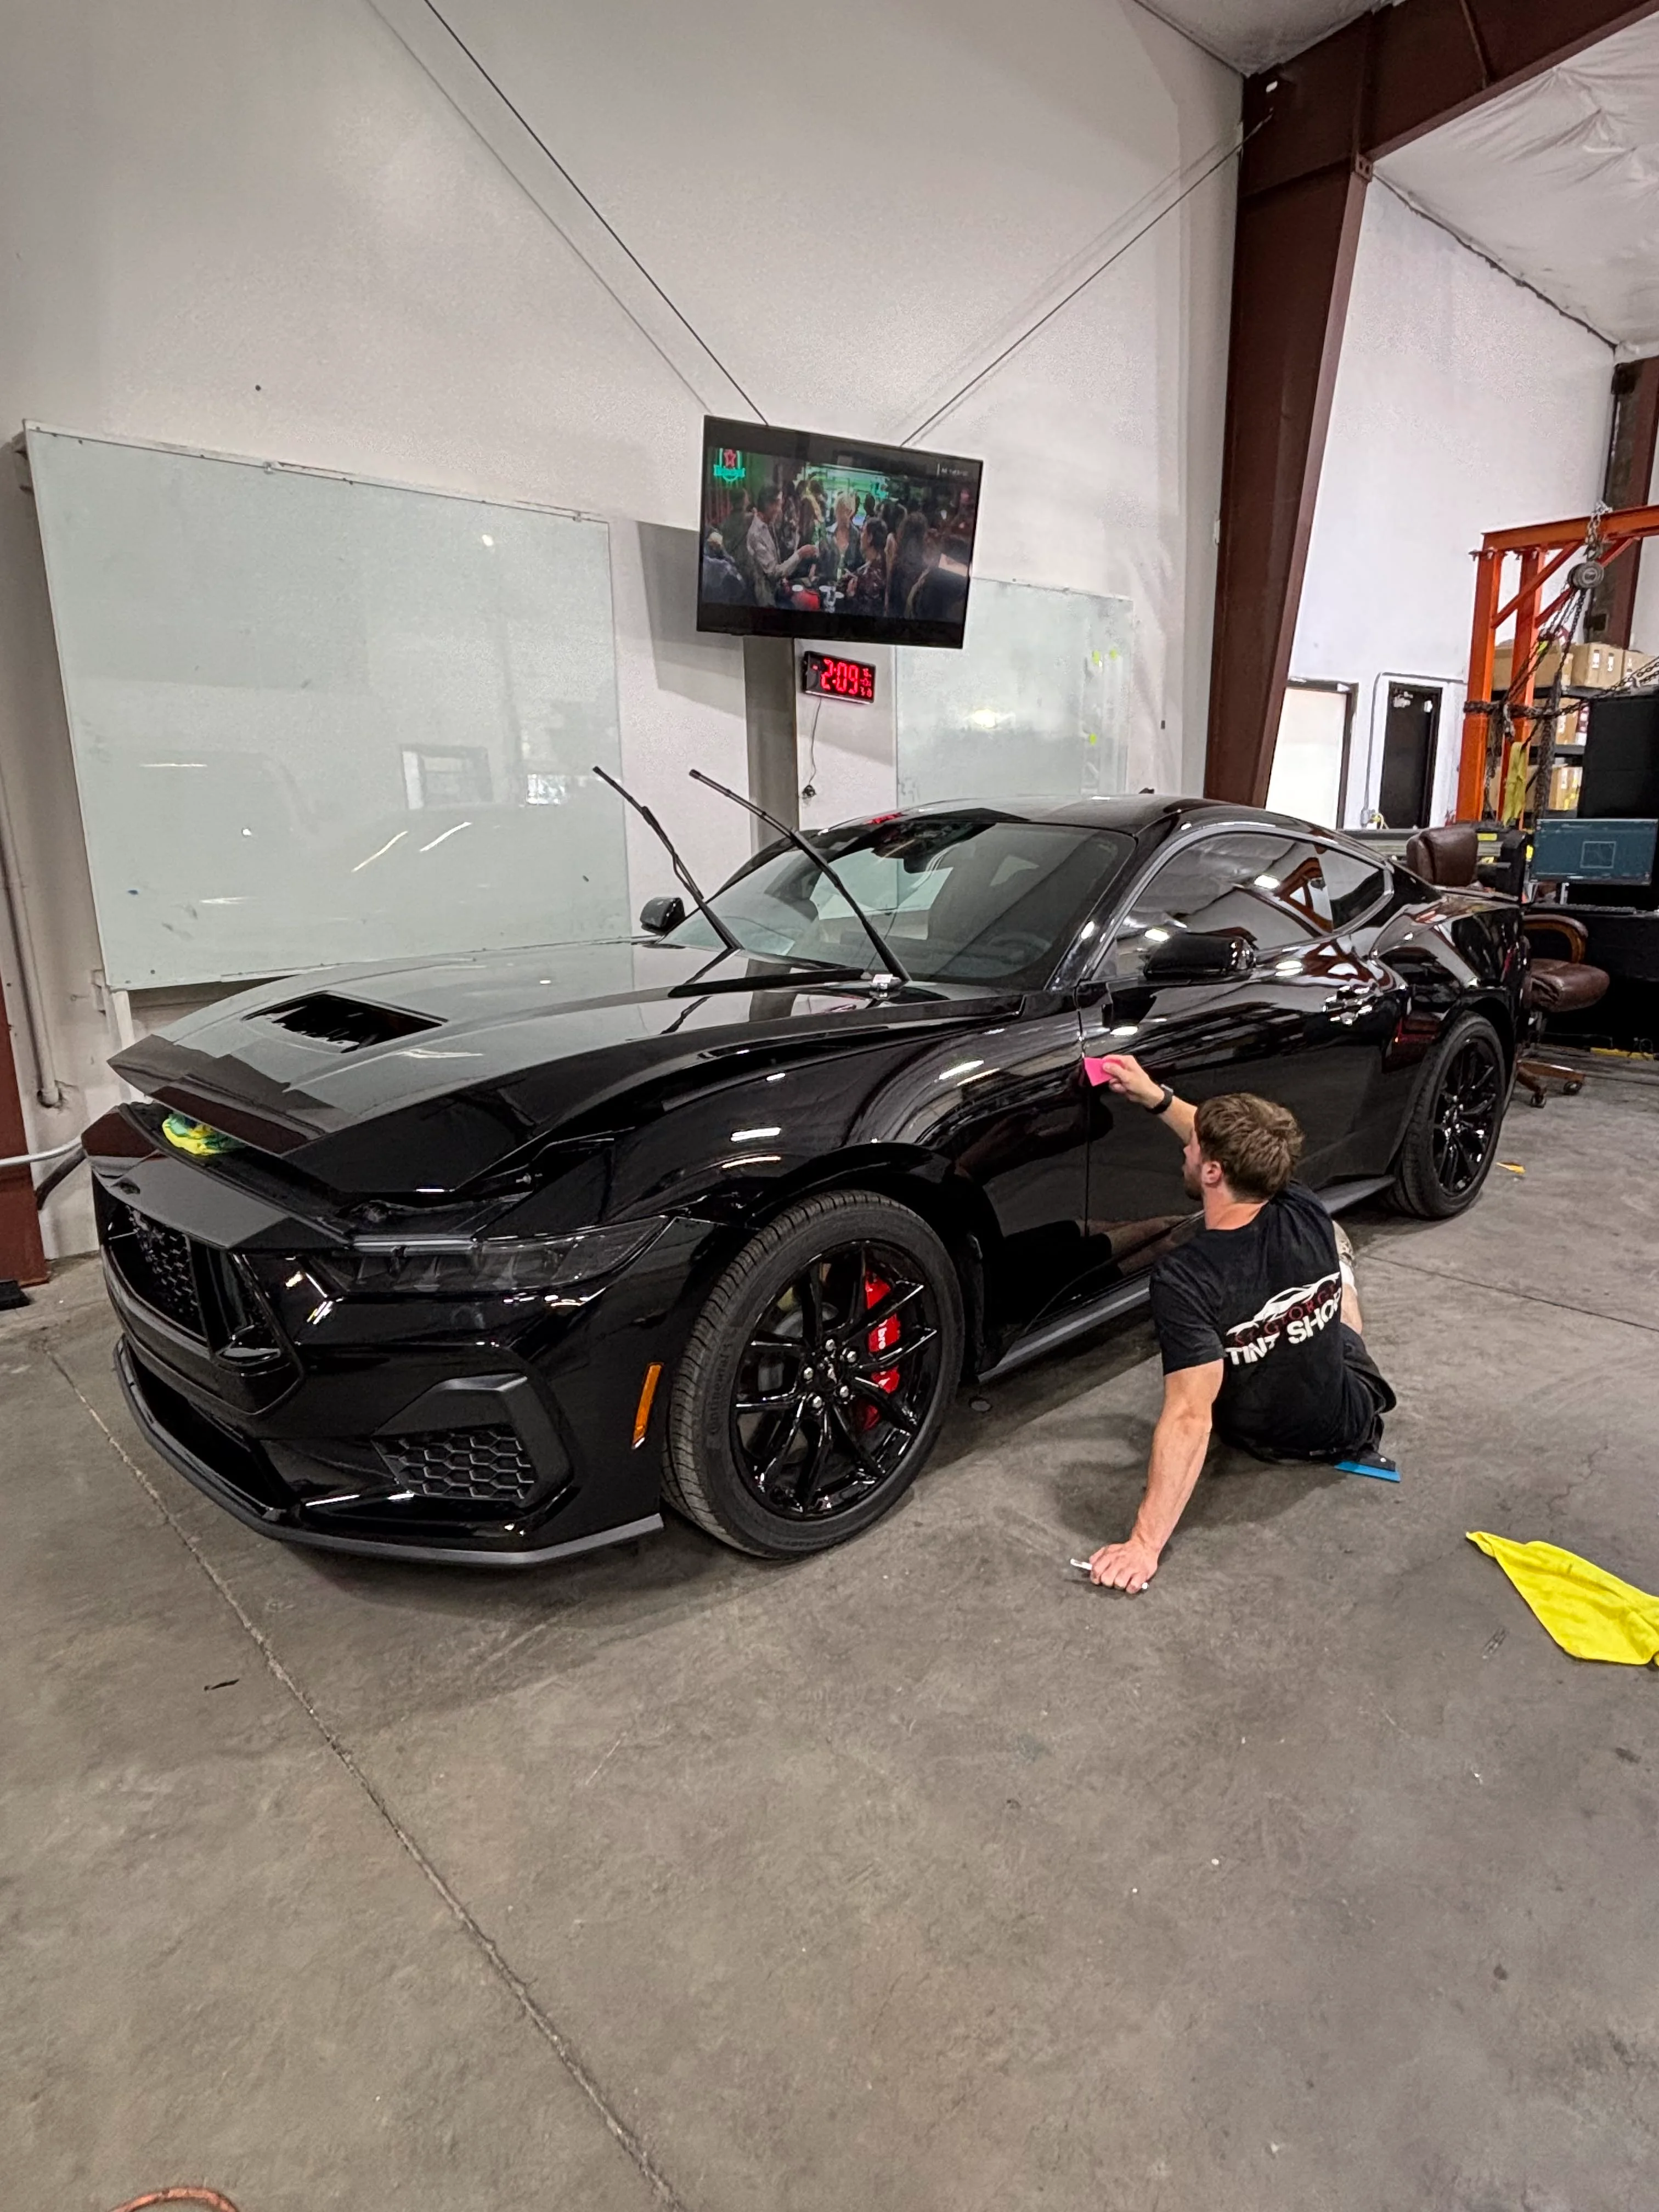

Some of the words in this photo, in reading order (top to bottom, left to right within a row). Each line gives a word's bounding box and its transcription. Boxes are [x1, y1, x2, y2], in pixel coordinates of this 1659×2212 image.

[821, 658, 859, 695] 2:09
[1225, 1332, 1280, 1365] TINT
[1286, 1287, 1341, 1344] SHOP
